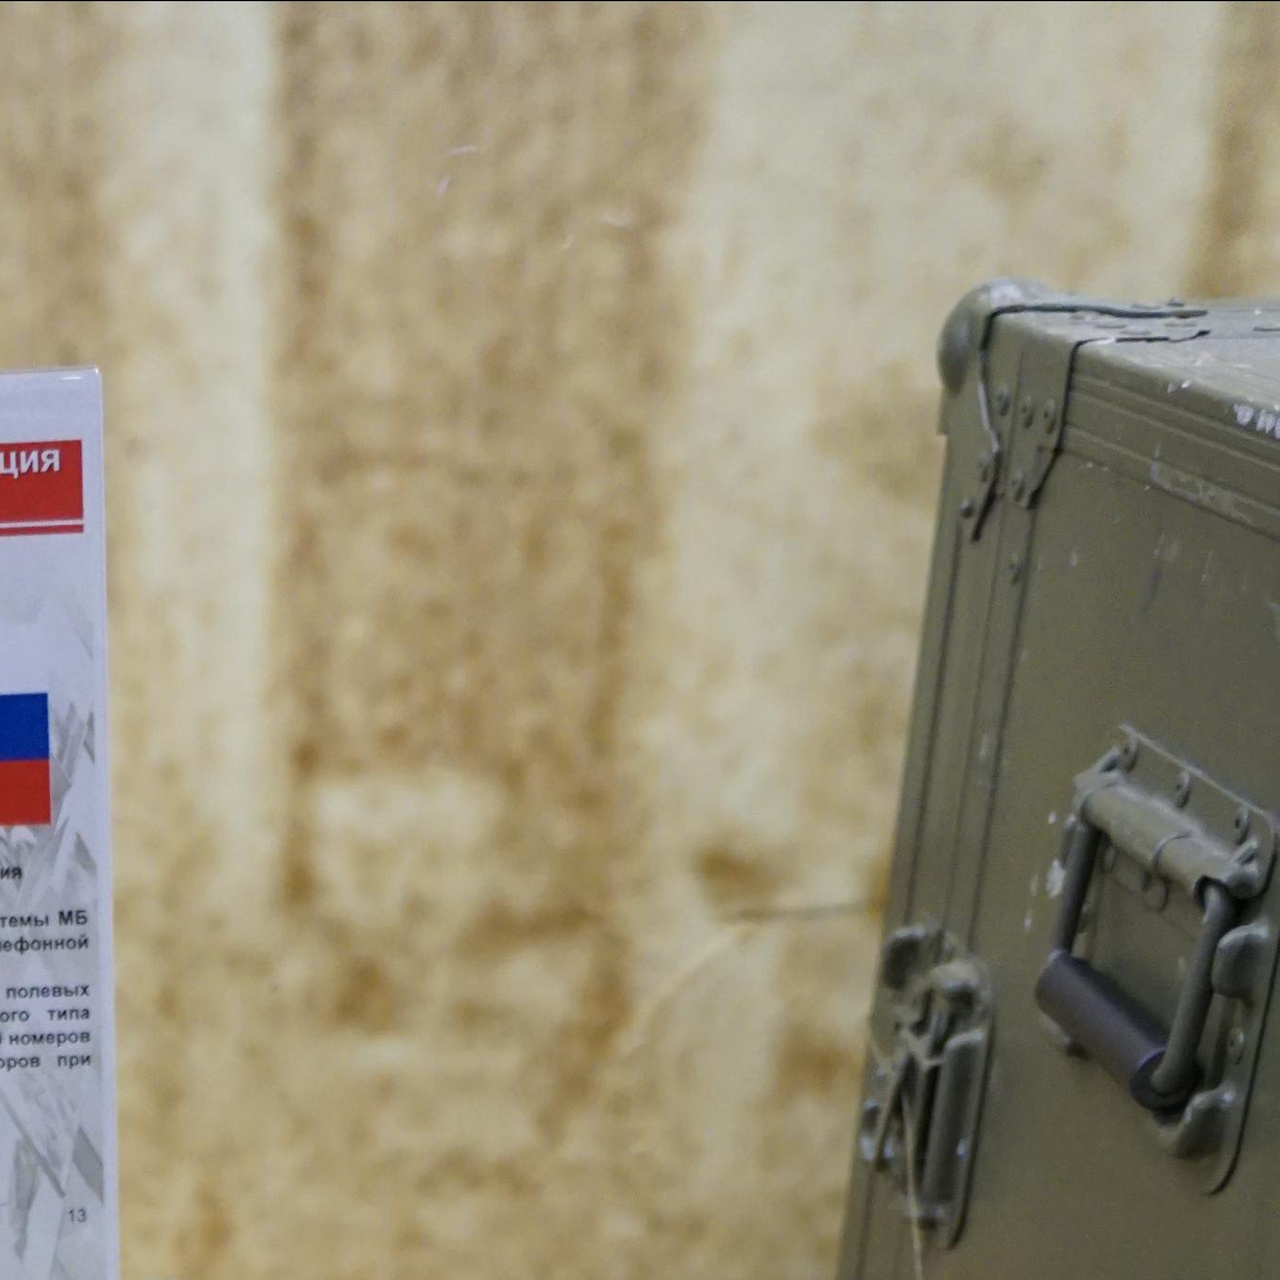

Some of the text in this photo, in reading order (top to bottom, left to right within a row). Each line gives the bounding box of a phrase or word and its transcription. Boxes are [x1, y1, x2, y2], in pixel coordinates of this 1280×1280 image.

[58, 907, 89, 924] МБ
[5, 984, 90, 999] полевых
[47, 1008, 90, 1021] типа
[8, 1031, 91, 1048] номеров
[57, 1054, 92, 1071] при
